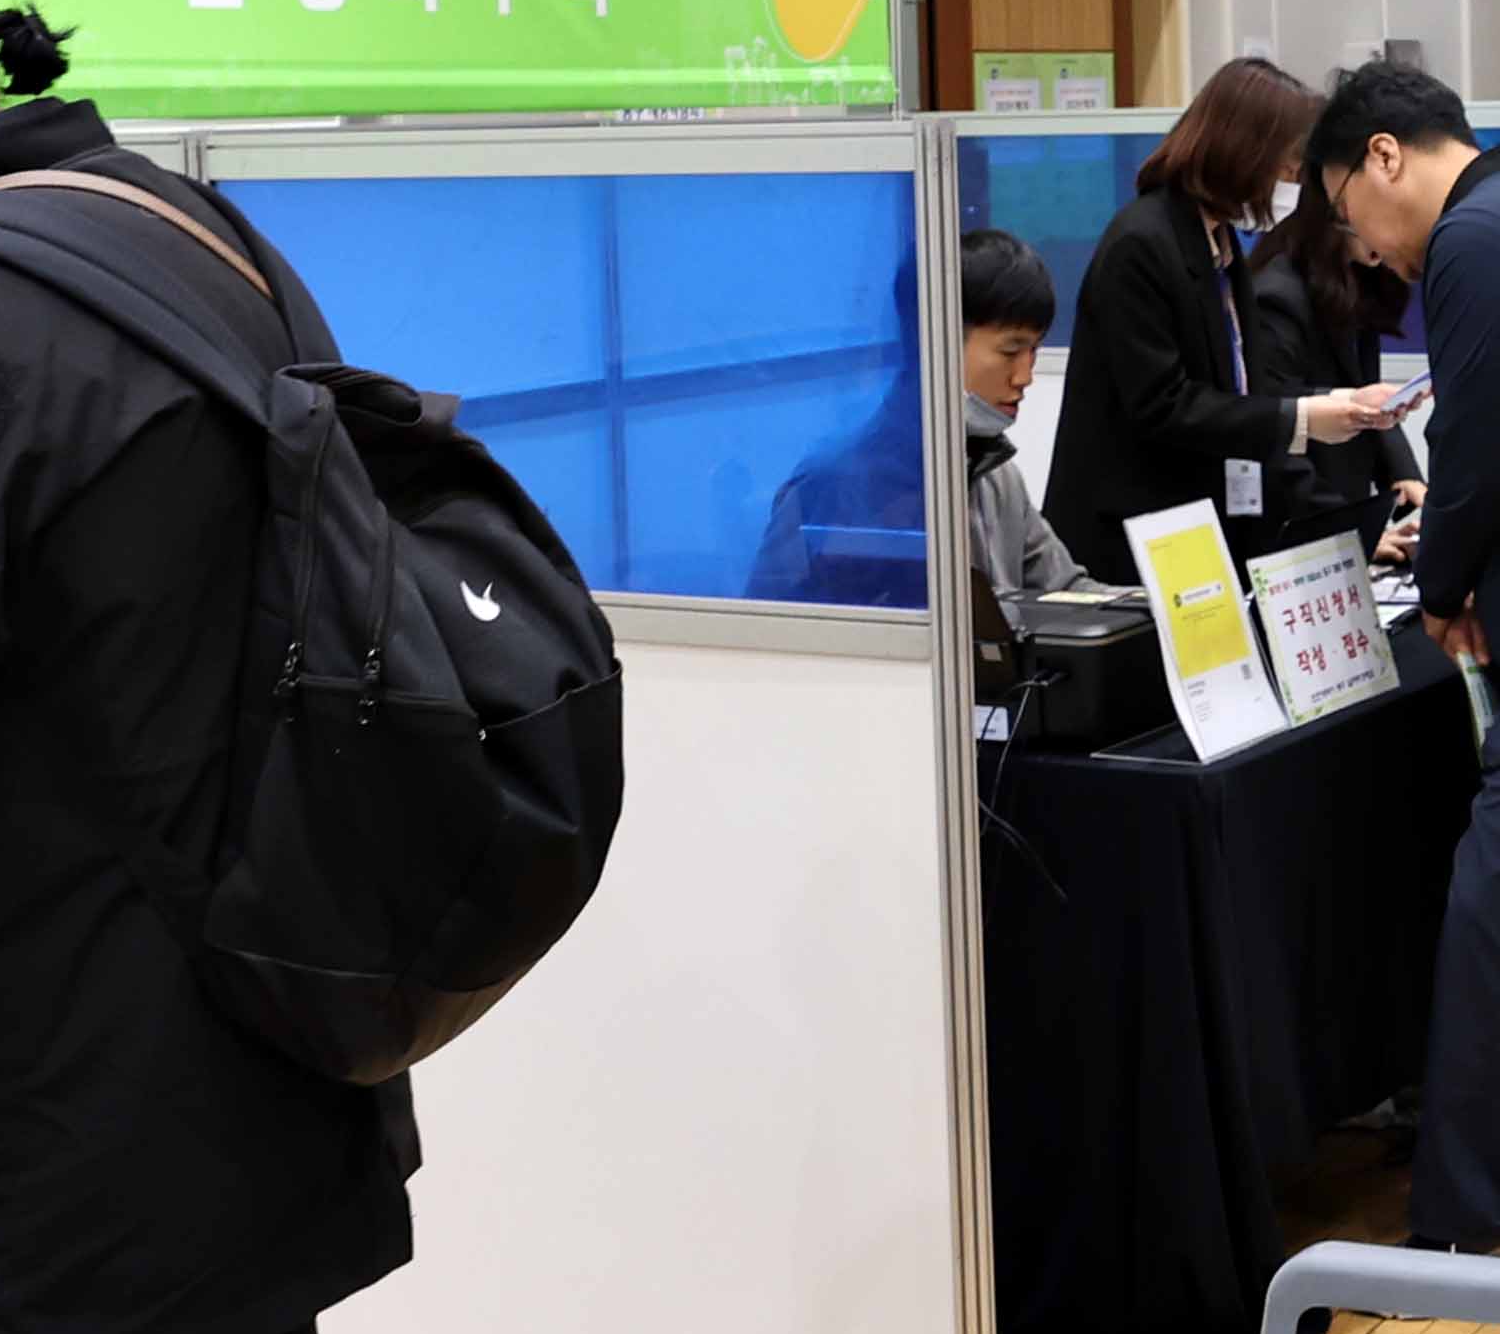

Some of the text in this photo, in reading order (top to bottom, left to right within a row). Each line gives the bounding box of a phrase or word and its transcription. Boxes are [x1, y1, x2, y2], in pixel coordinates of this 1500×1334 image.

[1282, 584, 1362, 635] 구직신청서
[1296, 628, 1370, 676] 작성 접수
